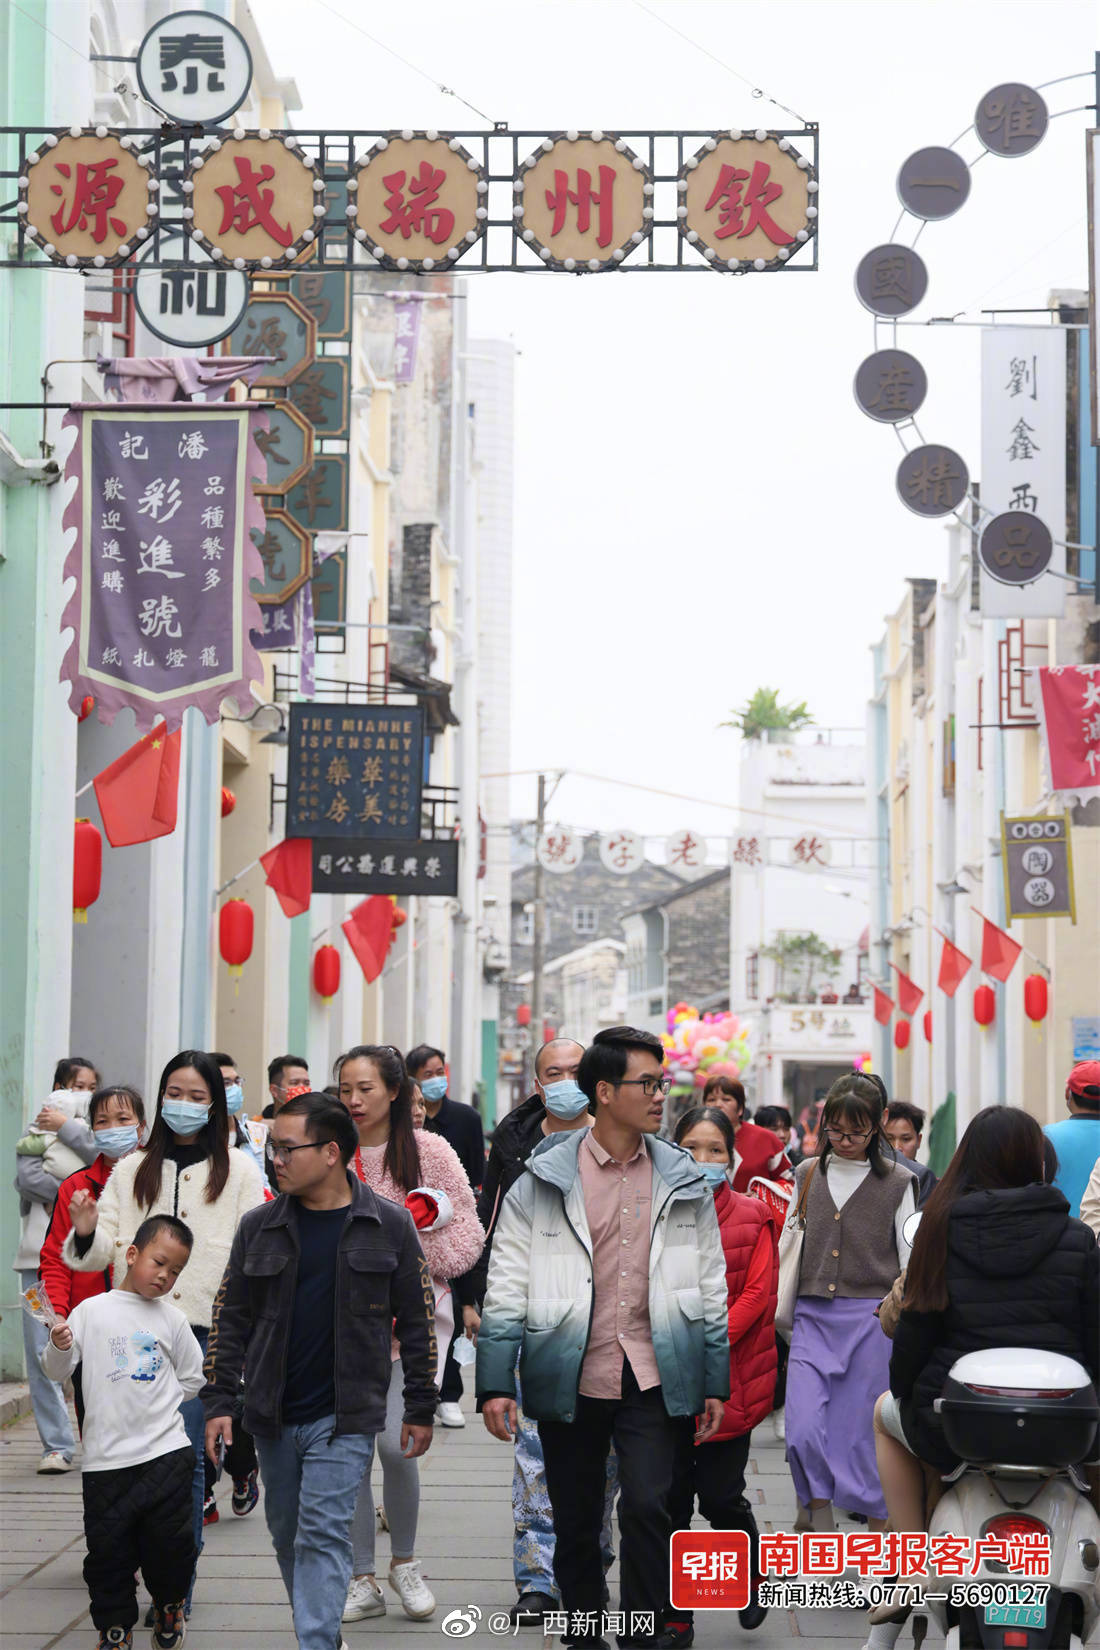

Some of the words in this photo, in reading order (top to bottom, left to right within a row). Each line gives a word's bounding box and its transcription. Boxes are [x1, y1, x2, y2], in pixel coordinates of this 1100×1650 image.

[200, 475, 225, 592] 品種繁多
[302, 718, 332, 732] THE
[989, 1607, 1042, 1625] P7779
